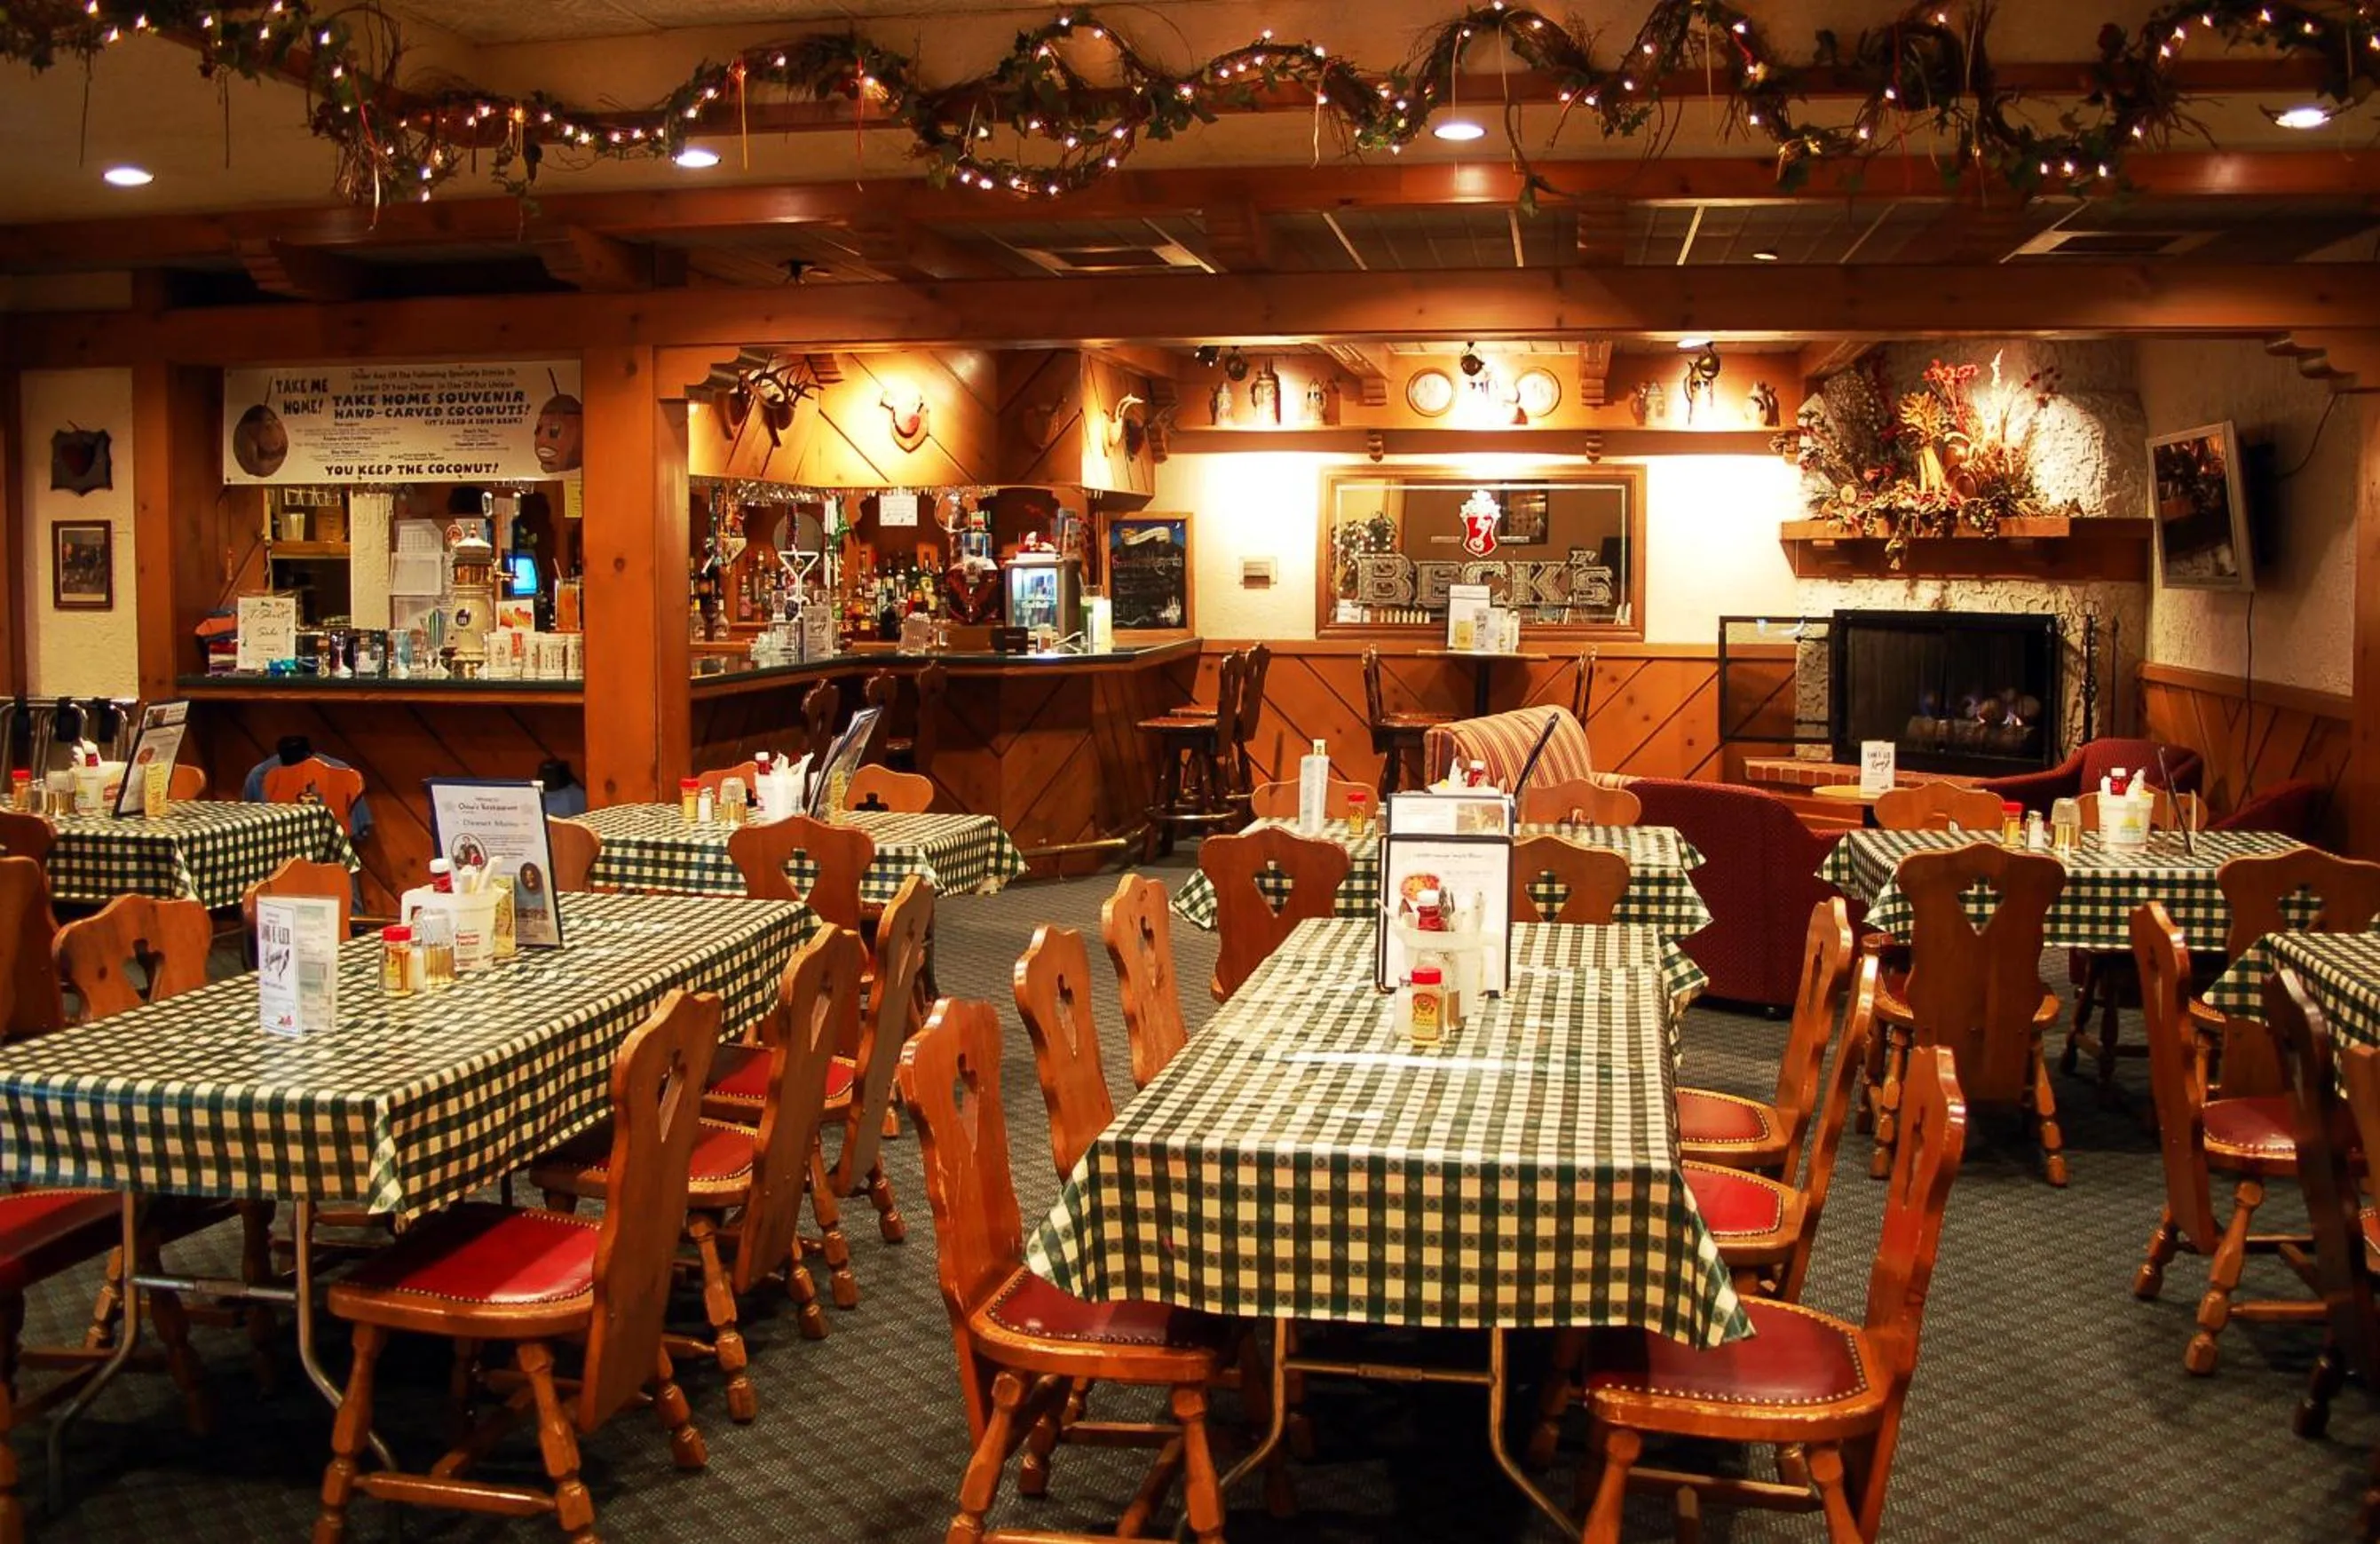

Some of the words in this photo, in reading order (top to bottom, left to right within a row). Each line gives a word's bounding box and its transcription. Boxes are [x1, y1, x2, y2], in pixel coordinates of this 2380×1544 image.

[275, 379, 307, 394] TAKE
[310, 378, 328, 392] ME
[332, 393, 376, 407] TAKE
[382, 392, 431, 406] HOME
[437, 391, 526, 404] SOUVENIR
[283, 399, 325, 416] HOME!
[334, 406, 443, 419] HAND-CARVED
[447, 404, 532, 416] COCONUTS!
[325, 464, 354, 477] YOU
[358, 464, 393, 475] KEEP
[397, 463, 423, 475] THE
[428, 462, 500, 475] COCONUT!
